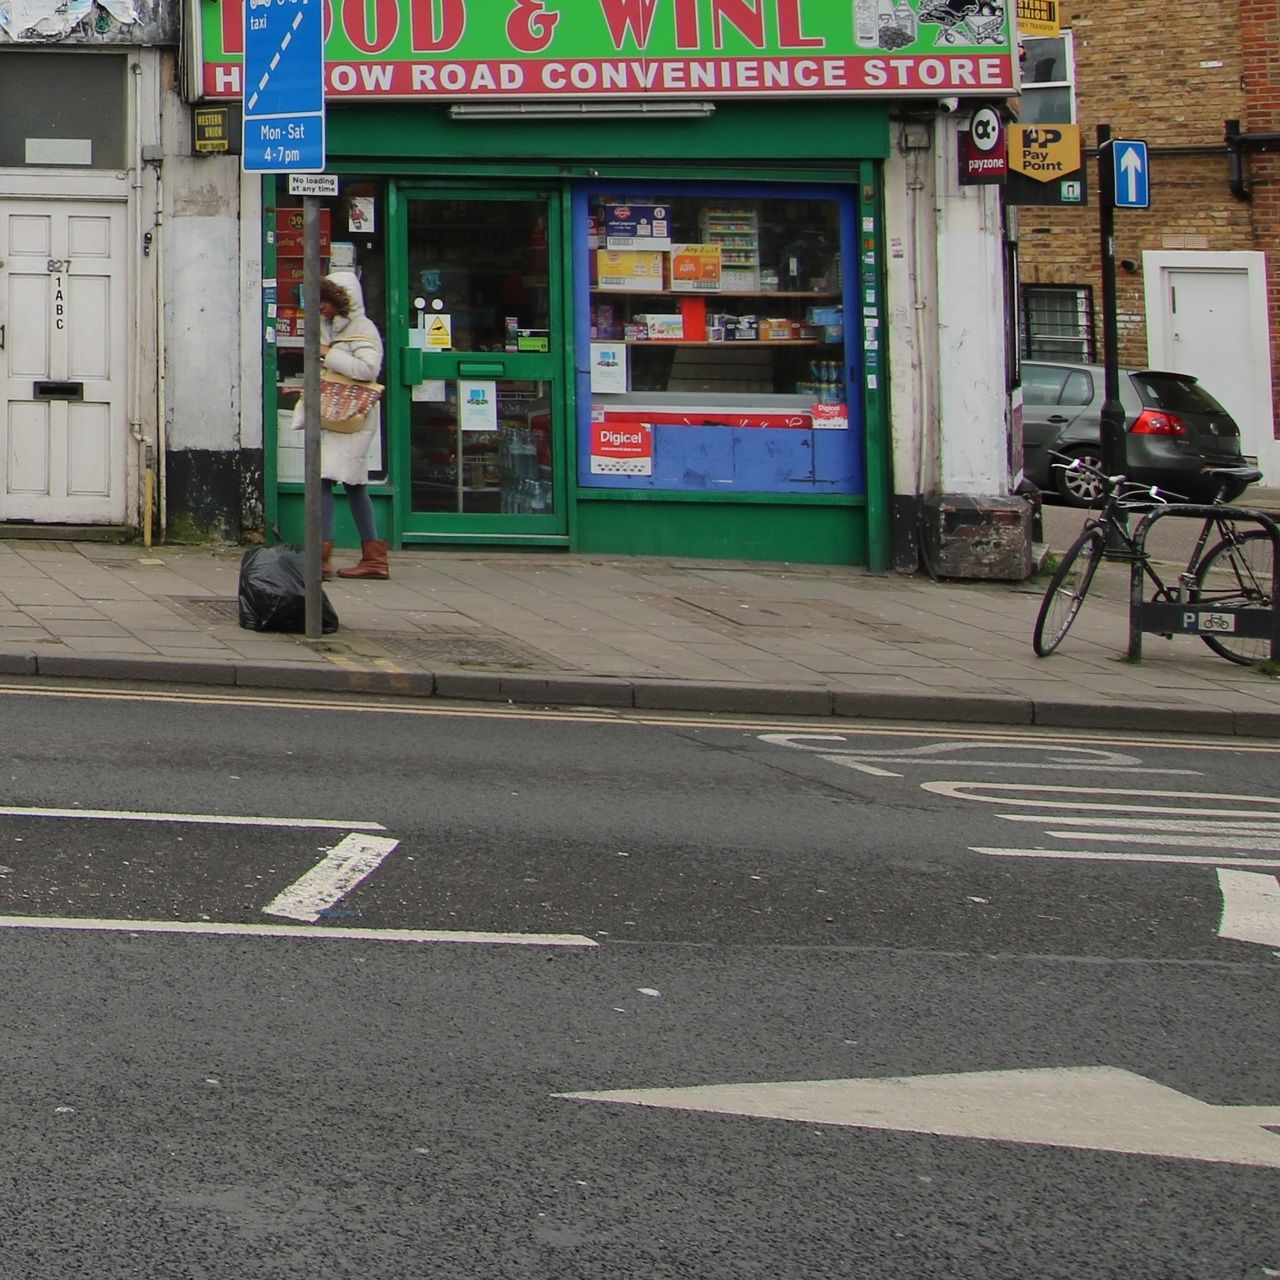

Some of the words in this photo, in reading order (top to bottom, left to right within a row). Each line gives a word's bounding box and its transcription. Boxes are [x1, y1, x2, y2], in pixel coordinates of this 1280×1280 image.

[1017, 8, 1047, 20] UNION
[250, 14, 267, 31] taxi
[215, 64, 394, 92] HOW
[411, 63, 524, 90] ROAD
[541, 59, 847, 89] CONVENIENCE
[864, 59, 1002, 87] STORE
[1022, 150, 1049, 162] Pay
[968, 157, 1004, 173] payzone
[1022, 160, 1063, 171] Point
[306, 177, 335, 185] loading
[47, 260, 72, 273] 827
[600, 431, 642, 445] Digicel
[1183, 612, 1195, 629] P
